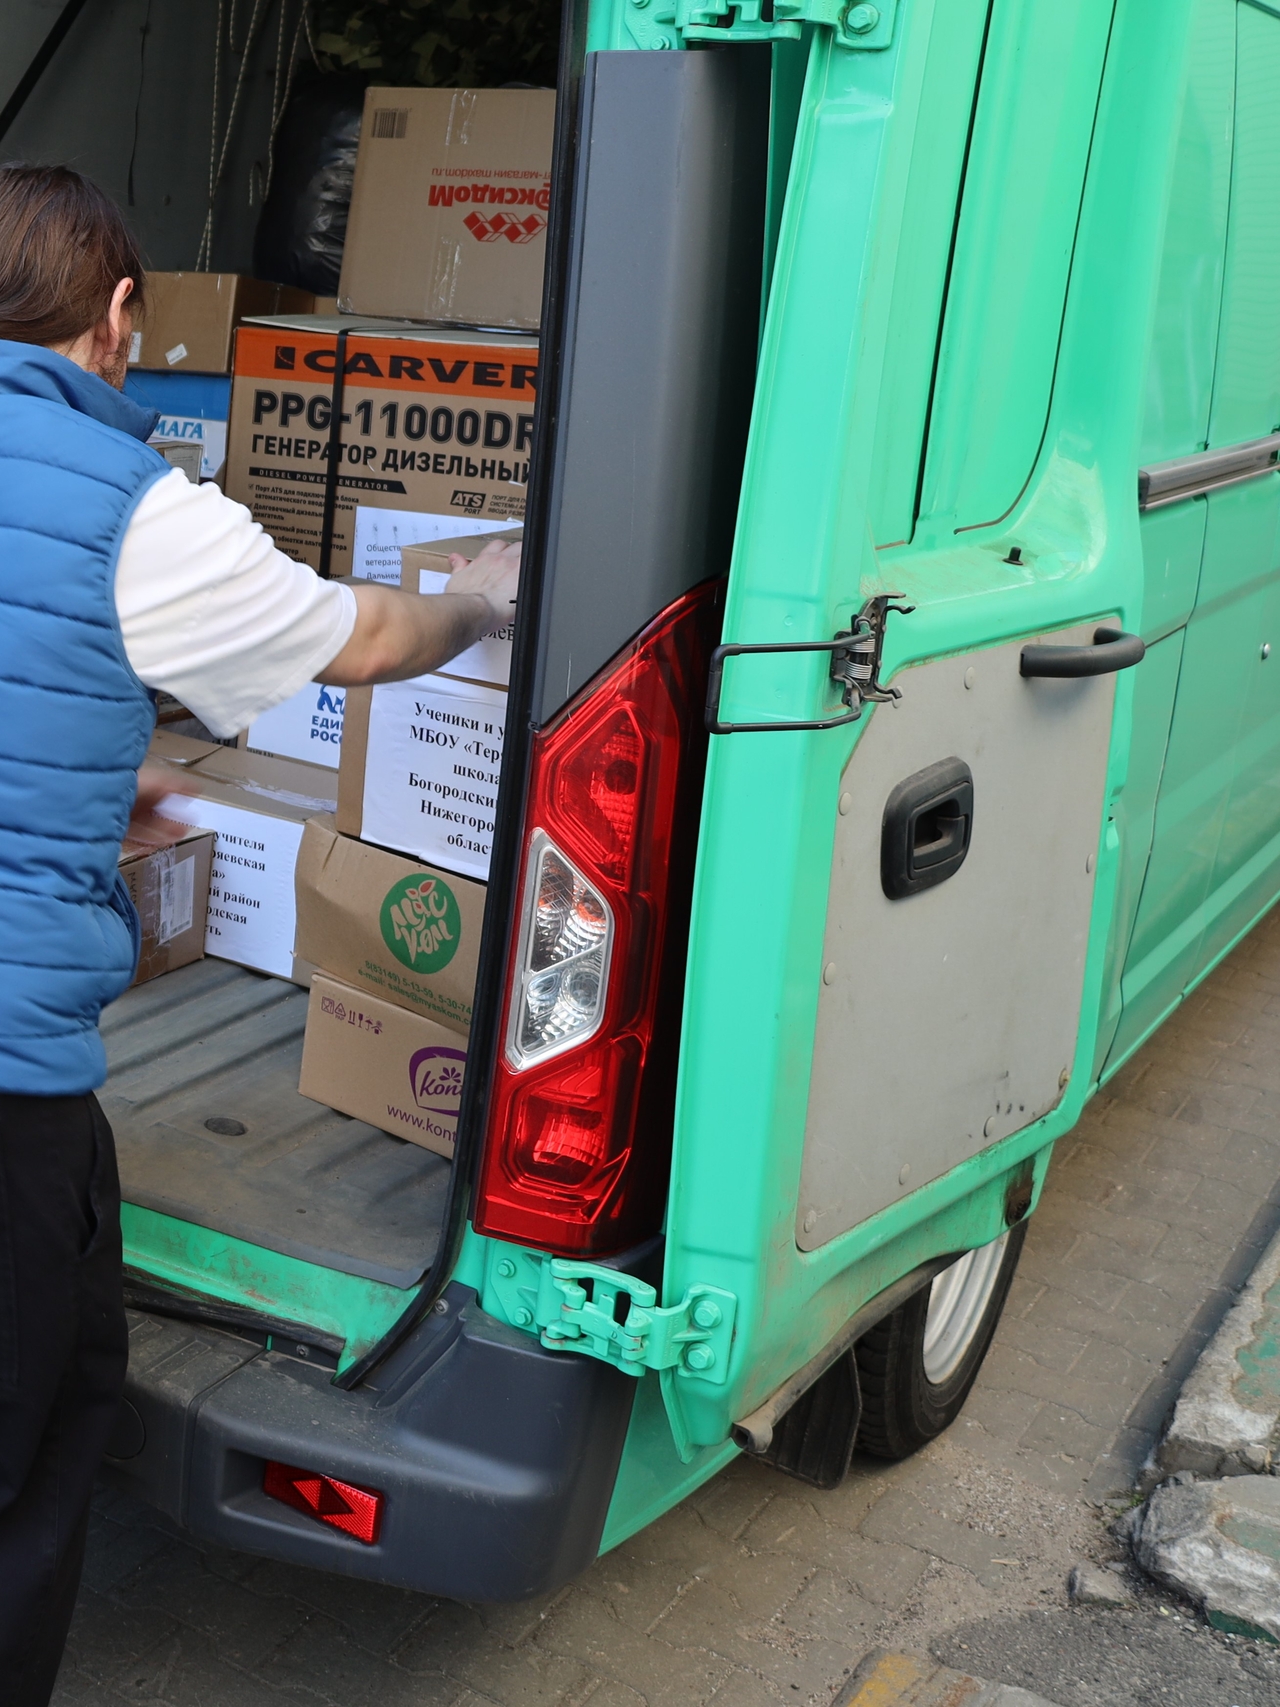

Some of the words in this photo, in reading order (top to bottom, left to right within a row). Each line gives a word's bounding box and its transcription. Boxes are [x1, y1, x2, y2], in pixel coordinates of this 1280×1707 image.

[431, 167, 492, 180] maxidom.ru
[303, 349, 537, 390] CARVER
[252, 433, 377, 466] ГЕНЕРАТОР
[255, 484, 271, 493] Порт
[271, 486, 283, 494] ATS
[259, 469, 291, 479] DIESEL
[296, 474, 327, 484] POWER
[336, 476, 388, 491] ENERATOR
[253, 503, 296, 514] Долговечный
[452, 492, 484, 507] ATS
[253, 511, 284, 521] двигатель
[463, 508, 482, 516] PORT
[296, 527, 318, 537] расход
[414, 701, 479, 731] Ученики
[484, 722, 493, 735] и
[409, 724, 460, 750] МБОУ
[463, 740, 504, 764] «Тер
[408, 771, 498, 810] Богородски
[420, 799, 495, 834] Нижегоро
[214, 831, 266, 852] учителя
[447, 833, 492, 855] облас
[223, 890, 261, 909] район
[365, 960, 401, 985] 8(83149)
[358, 968, 386, 987] e-mail:
[387, 982, 471, 1026] sales@myaskom.c
